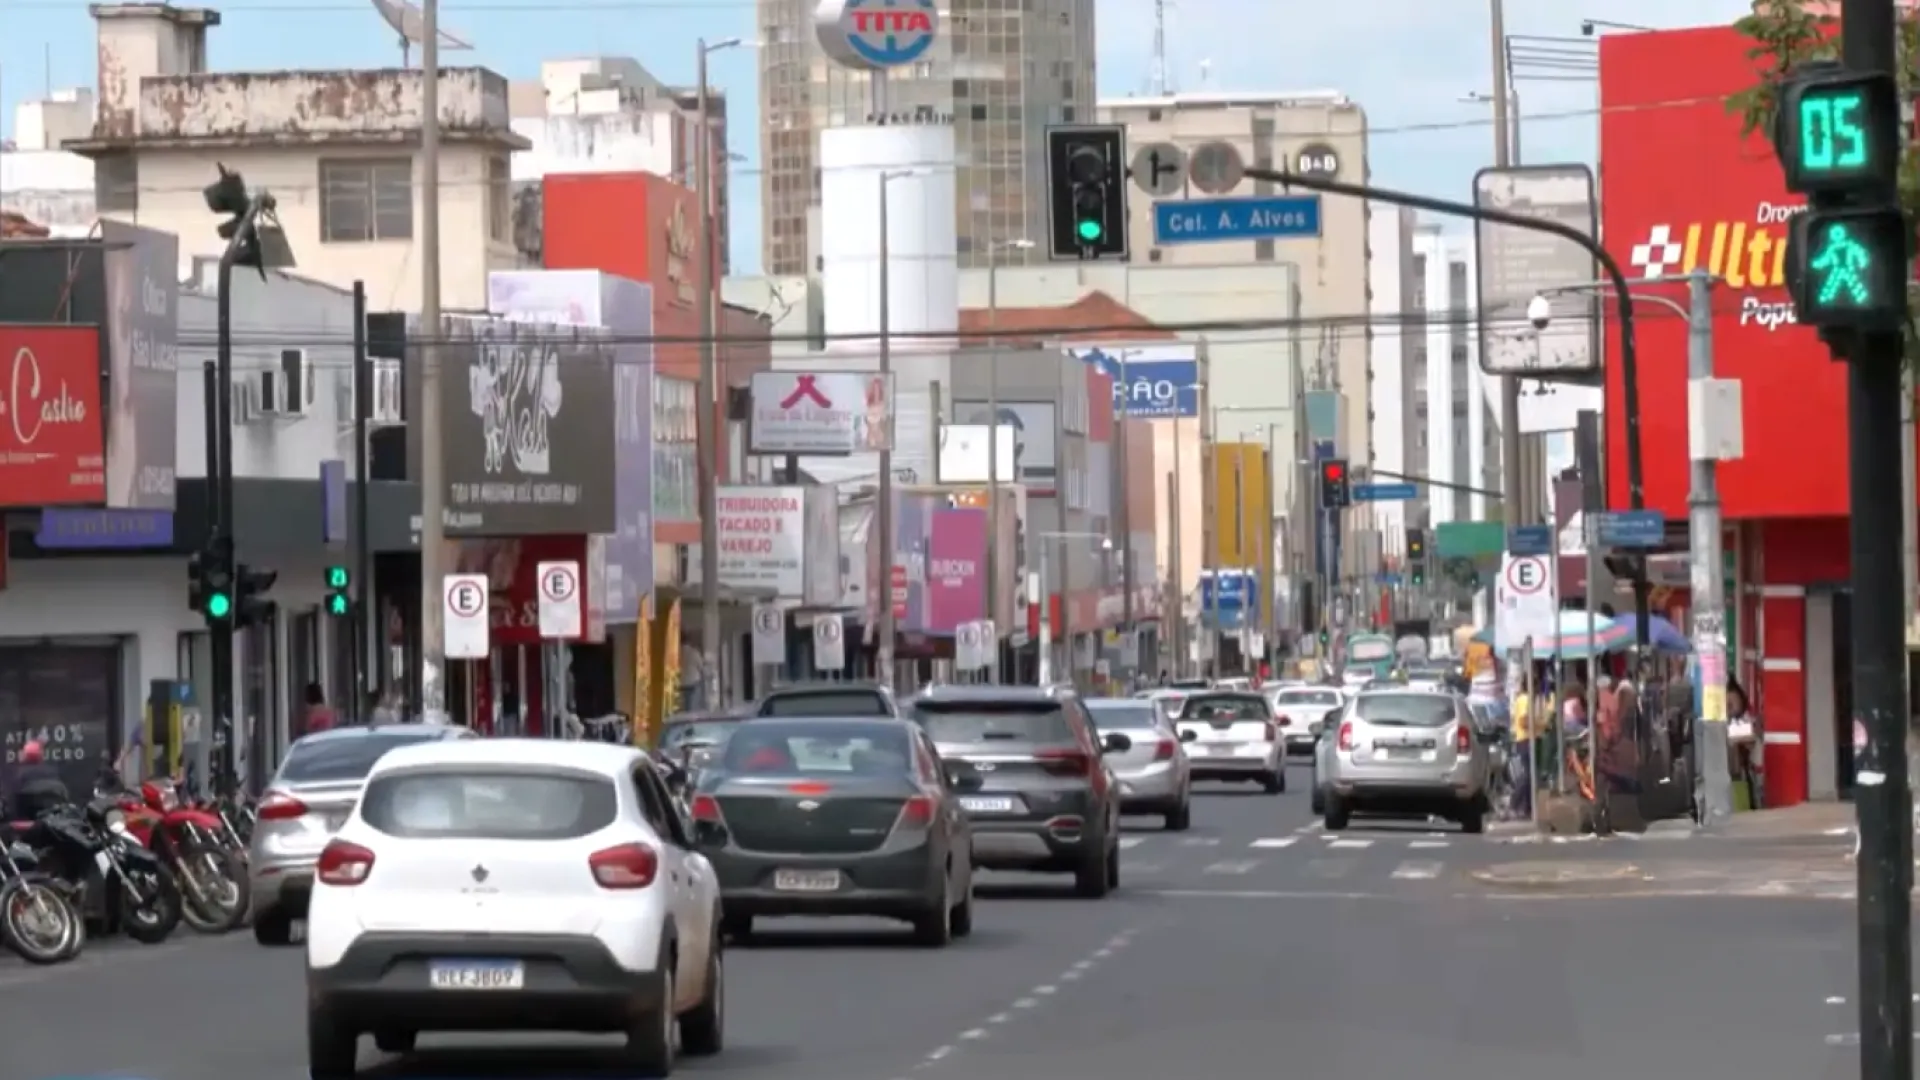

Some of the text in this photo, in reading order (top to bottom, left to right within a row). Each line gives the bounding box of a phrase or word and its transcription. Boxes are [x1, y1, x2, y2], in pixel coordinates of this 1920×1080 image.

[853, 11, 931, 32] TITA
[1801, 96, 1864, 168] 05
[1299, 154, 1337, 172] B&B
[1168, 207, 1306, 232] Cel. A. Alves
[1756, 200, 1808, 224] Dro
[718, 496, 799, 512] TRIBUIDORA
[720, 537, 773, 554] VAREJO
[552, 574, 565, 596] E
[1519, 563, 1534, 586] E
[458, 587, 473, 610] E
[43, 748, 85, 761] UCRO
